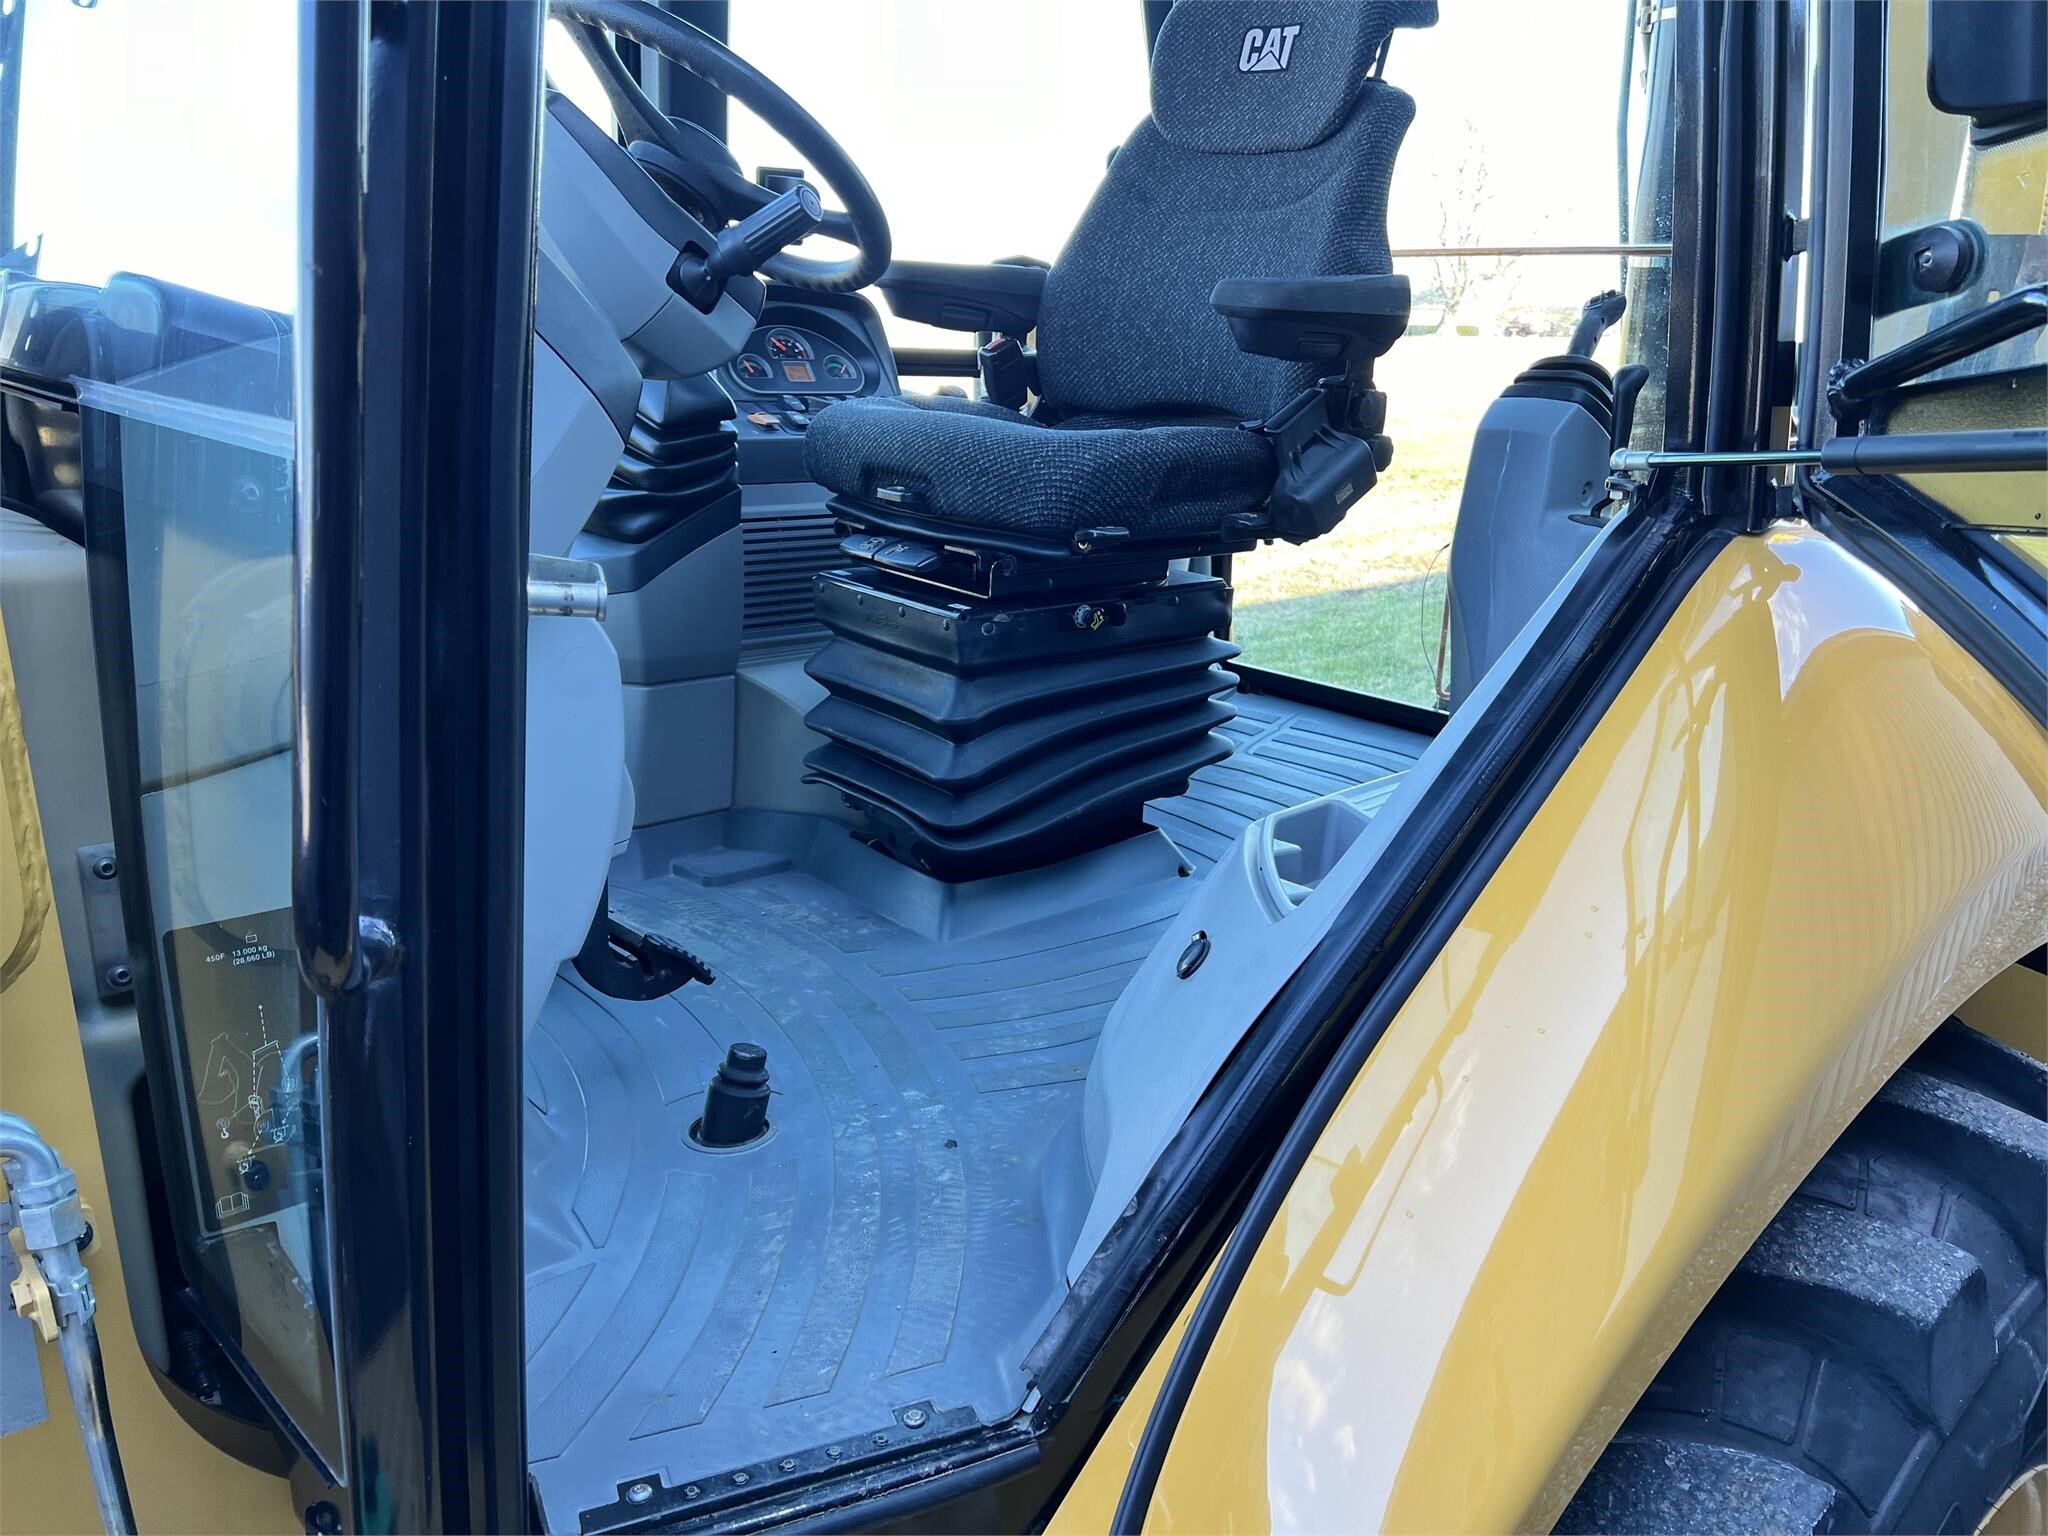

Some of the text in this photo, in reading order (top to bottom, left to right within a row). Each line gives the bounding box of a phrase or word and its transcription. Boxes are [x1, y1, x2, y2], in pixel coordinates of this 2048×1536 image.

[1239, 25, 1300, 72] CAT
[258, 944, 268, 952] kg
[205, 952, 225, 963] 450F
[261, 950, 275, 959] LB)
